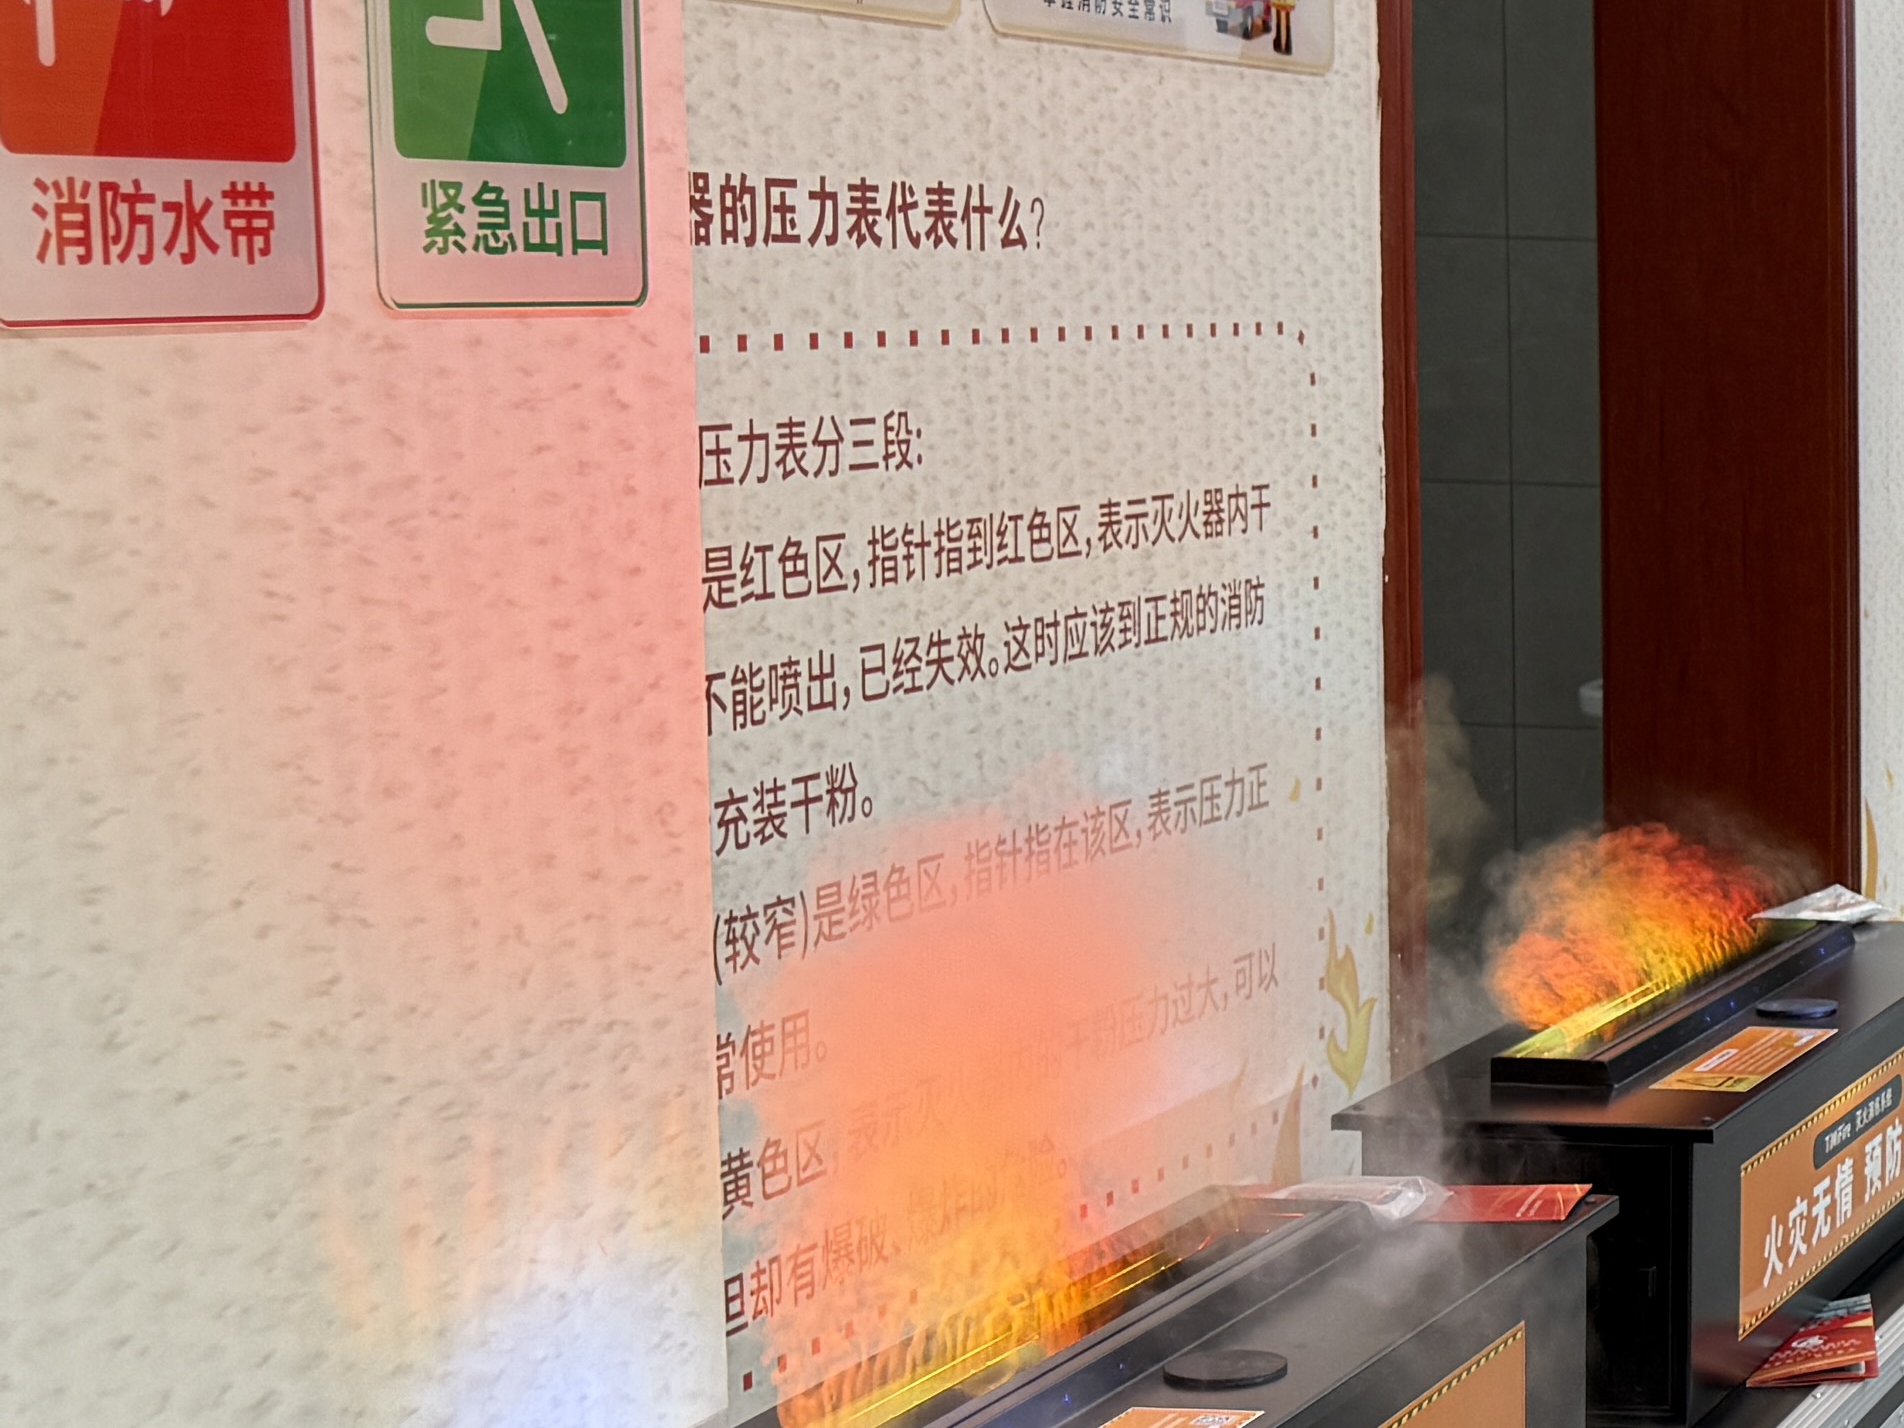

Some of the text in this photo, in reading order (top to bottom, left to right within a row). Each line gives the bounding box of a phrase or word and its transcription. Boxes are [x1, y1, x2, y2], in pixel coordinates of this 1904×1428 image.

[31, 175, 276, 265] 消防水带
[419, 178, 610, 257] 紧急出口
[713, 761, 875, 858] 充装干粉。
[1762, 1156, 1855, 1289] 火灾无情
